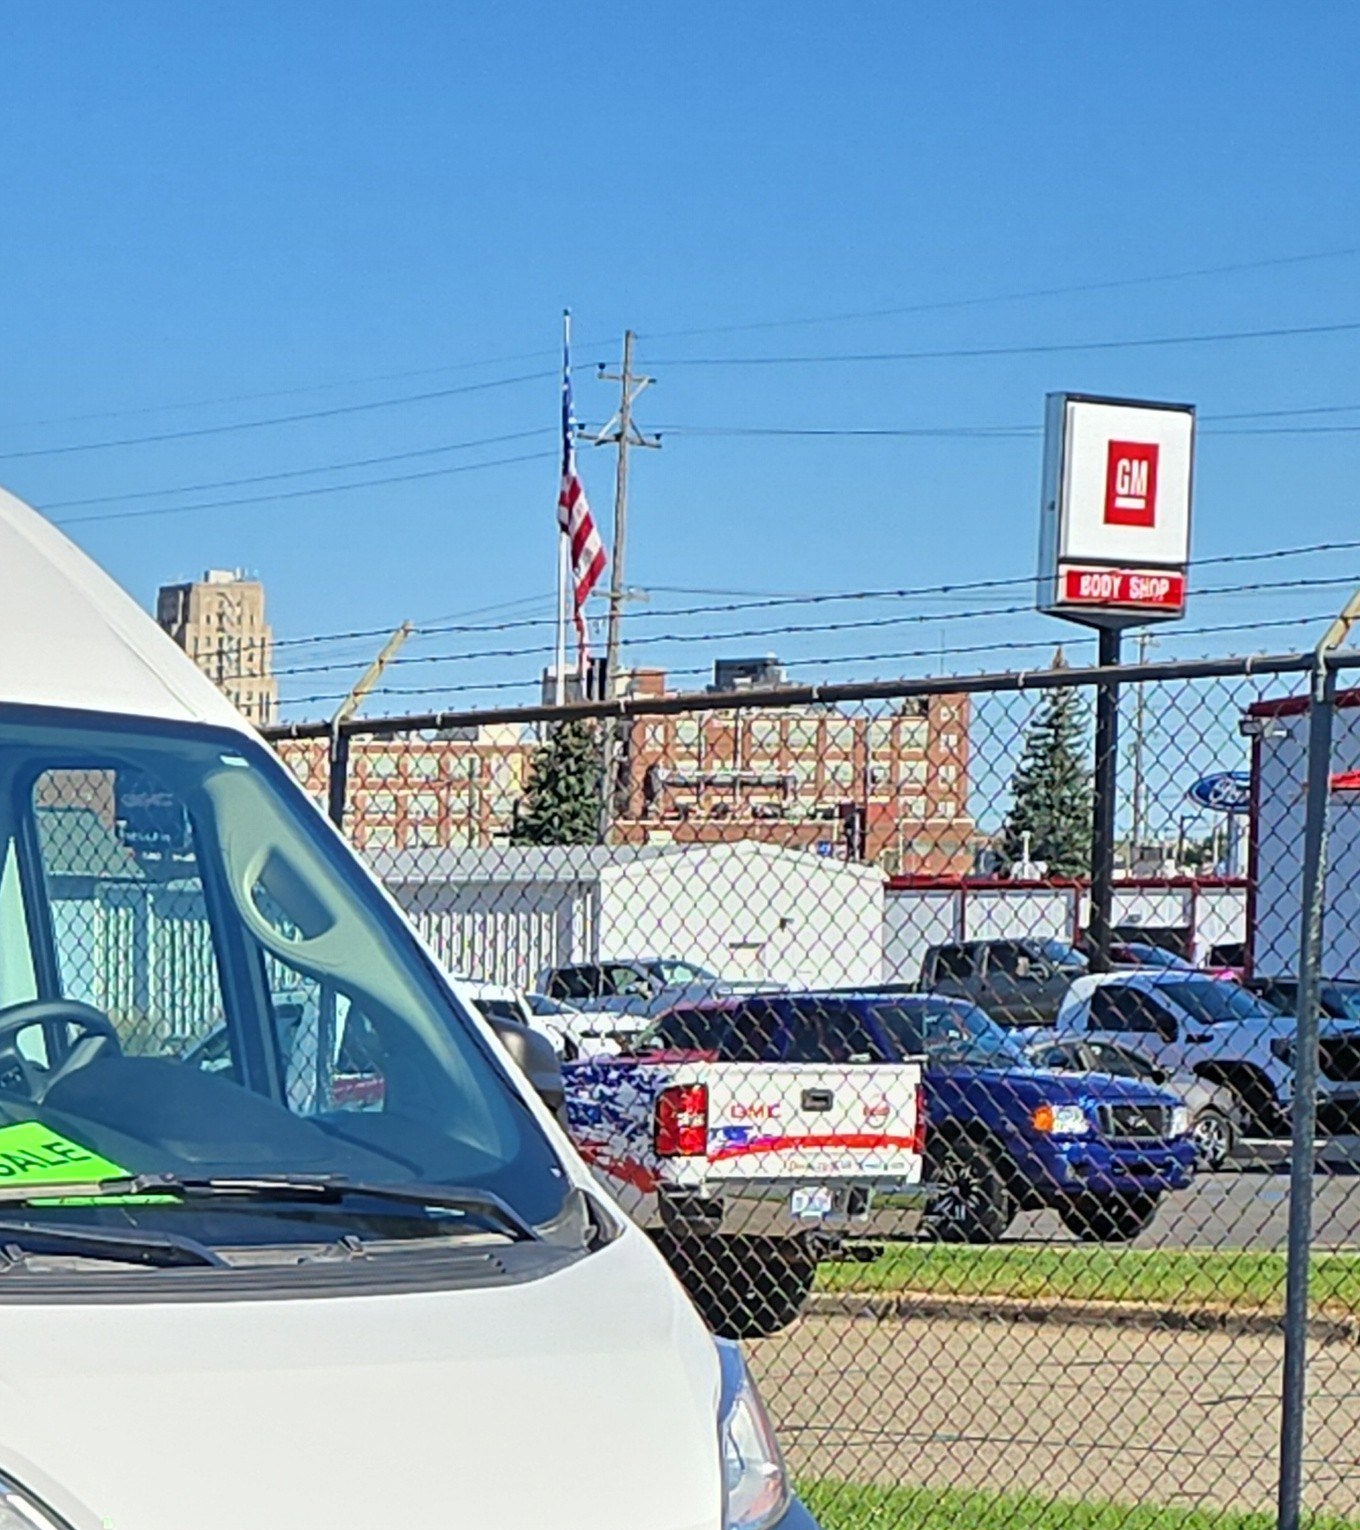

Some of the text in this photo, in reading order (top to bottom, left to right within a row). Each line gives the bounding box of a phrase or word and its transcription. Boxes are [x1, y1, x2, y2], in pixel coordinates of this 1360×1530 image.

[1116, 458, 1149, 497] GM
[1080, 574, 1170, 600] BODY SHOP
